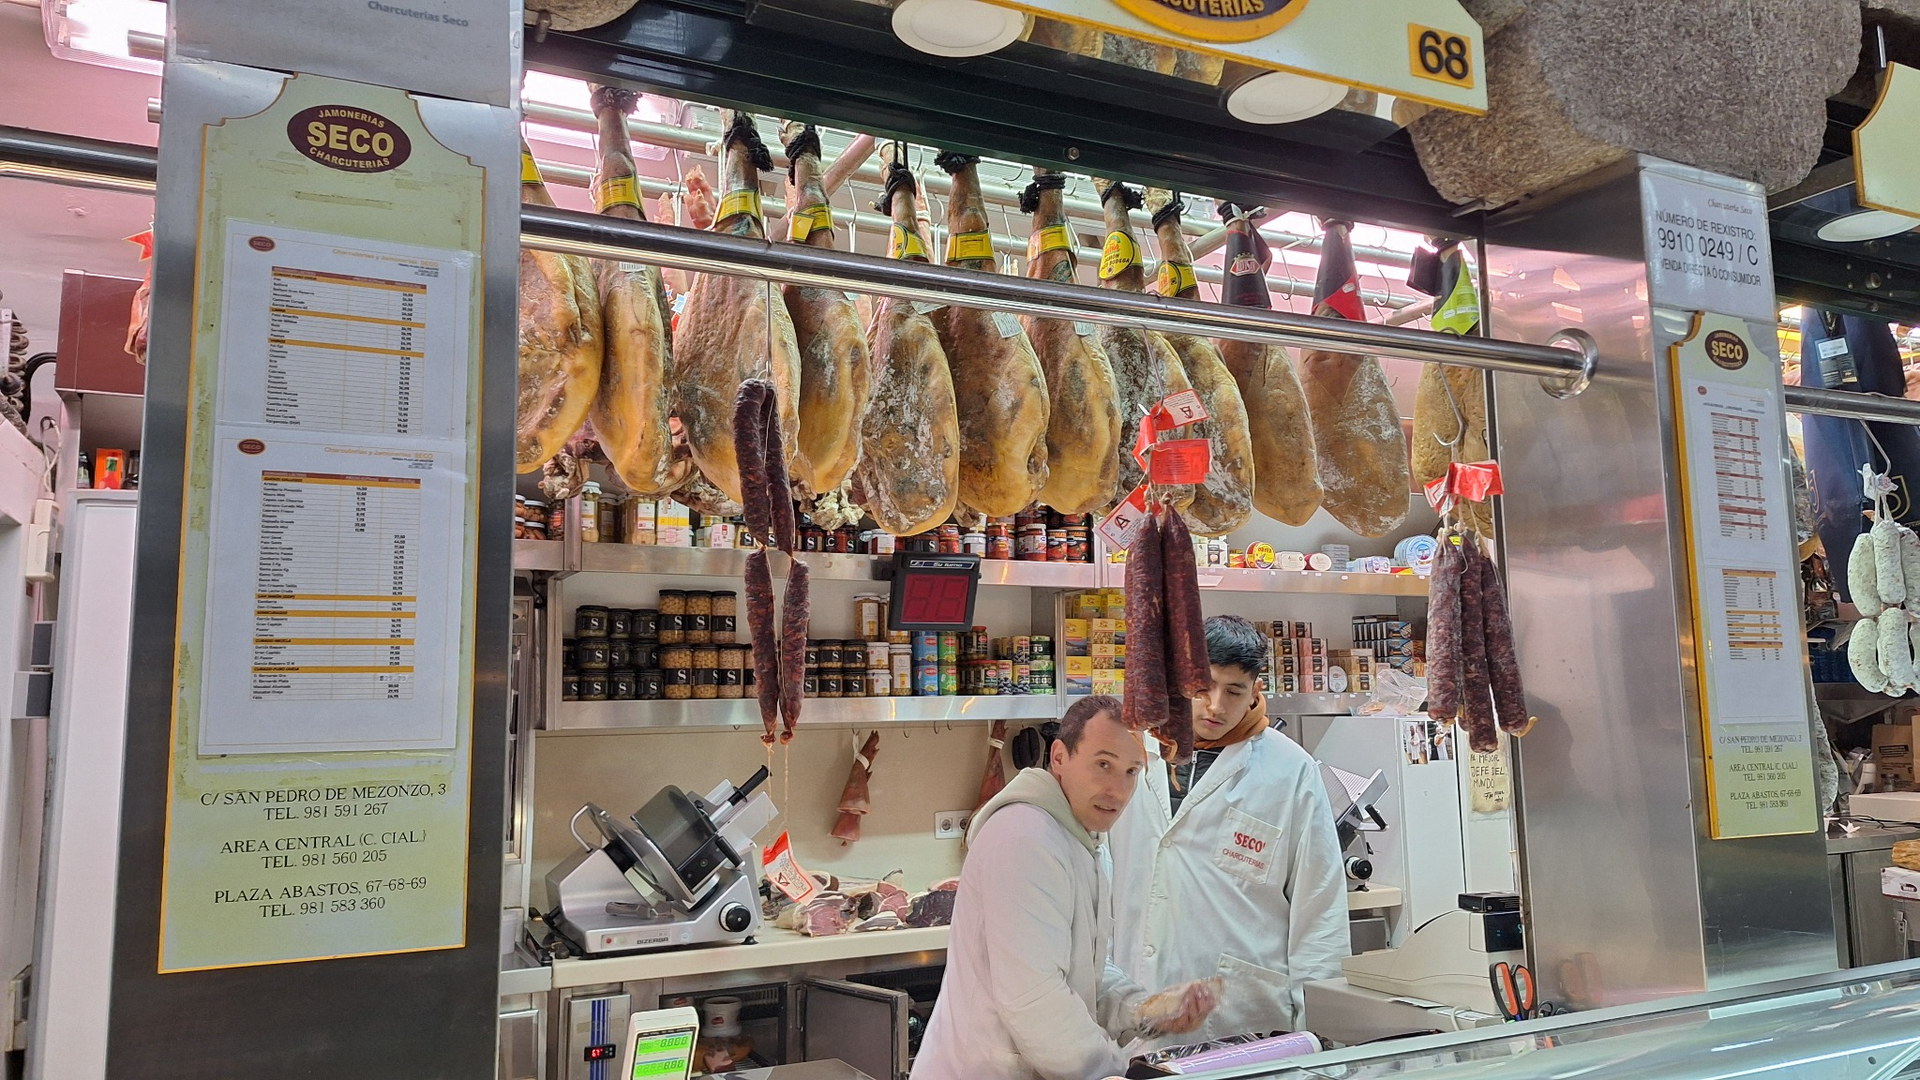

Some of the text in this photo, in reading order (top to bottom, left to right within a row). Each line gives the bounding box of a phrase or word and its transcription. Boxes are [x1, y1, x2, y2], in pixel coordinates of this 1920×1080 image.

[443, 14, 469, 27] Seco
[1419, 30, 1469, 80] 68
[318, 109, 385, 128] JAMONERIAS
[307, 121, 395, 157] SECO
[309, 147, 390, 168] CHARCUTERIAS
[1656, 209, 1757, 241] NÚMERO DE REXISTRO:
[1658, 228, 1694, 253] 9910
[1699, 236, 1734, 261] 0249
[1747, 245, 1758, 266] C
[1718, 269, 1761, 286] CONSUMIDOR
[1711, 340, 1743, 360] SECO
[744, 533, 751, 541] S
[768, 534, 775, 542] S
[807, 537, 815, 545] S
[591, 618, 599, 627] S
[616, 621, 624, 629] S
[674, 616, 682, 625] S
[697, 616, 705, 625] S
[725, 616, 733, 626] S
[650, 622, 656, 630] S
[595, 650, 603, 658] S
[612, 652, 619, 660] S
[652, 652, 657, 660] S
[810, 652, 815, 660] S
[832, 651, 839, 659] S
[677, 670, 686, 680] S
[712, 669, 718, 680] S
[727, 670, 736, 680] S
[571, 683, 578, 691] S
[594, 682, 601, 691] S
[619, 682, 627, 691] S
[650, 682, 657, 690] S
[852, 680, 859, 688] S
[1761, 735, 1768, 743] DE
[1470, 766, 1505, 777] JEFE DEL
[1729, 764, 1746, 772] AREA
[1747, 763, 1774, 771] CENTRAL
[1474, 778, 1494, 789] MUNDO
[201, 783, 447, 806] C/ SAN PEDRO DE MEZONZO, 3
[1730, 792, 1750, 800] PLAZA
[263, 803, 389, 821] TEL. 981 591 267
[220, 839, 270, 853] AREA
[275, 835, 355, 851] CENTRAL
[359, 833, 377, 847] (C.
[1234, 832, 1266, 853] 'SECO'
[261, 850, 387, 869] TEL. 981 560 205
[1222, 848, 1265, 869] CHARCUTERIAS
[215, 877, 427, 903] PLAZA ABASTOS, 67-68-69
[259, 897, 385, 918] TEL. 981 583 360
